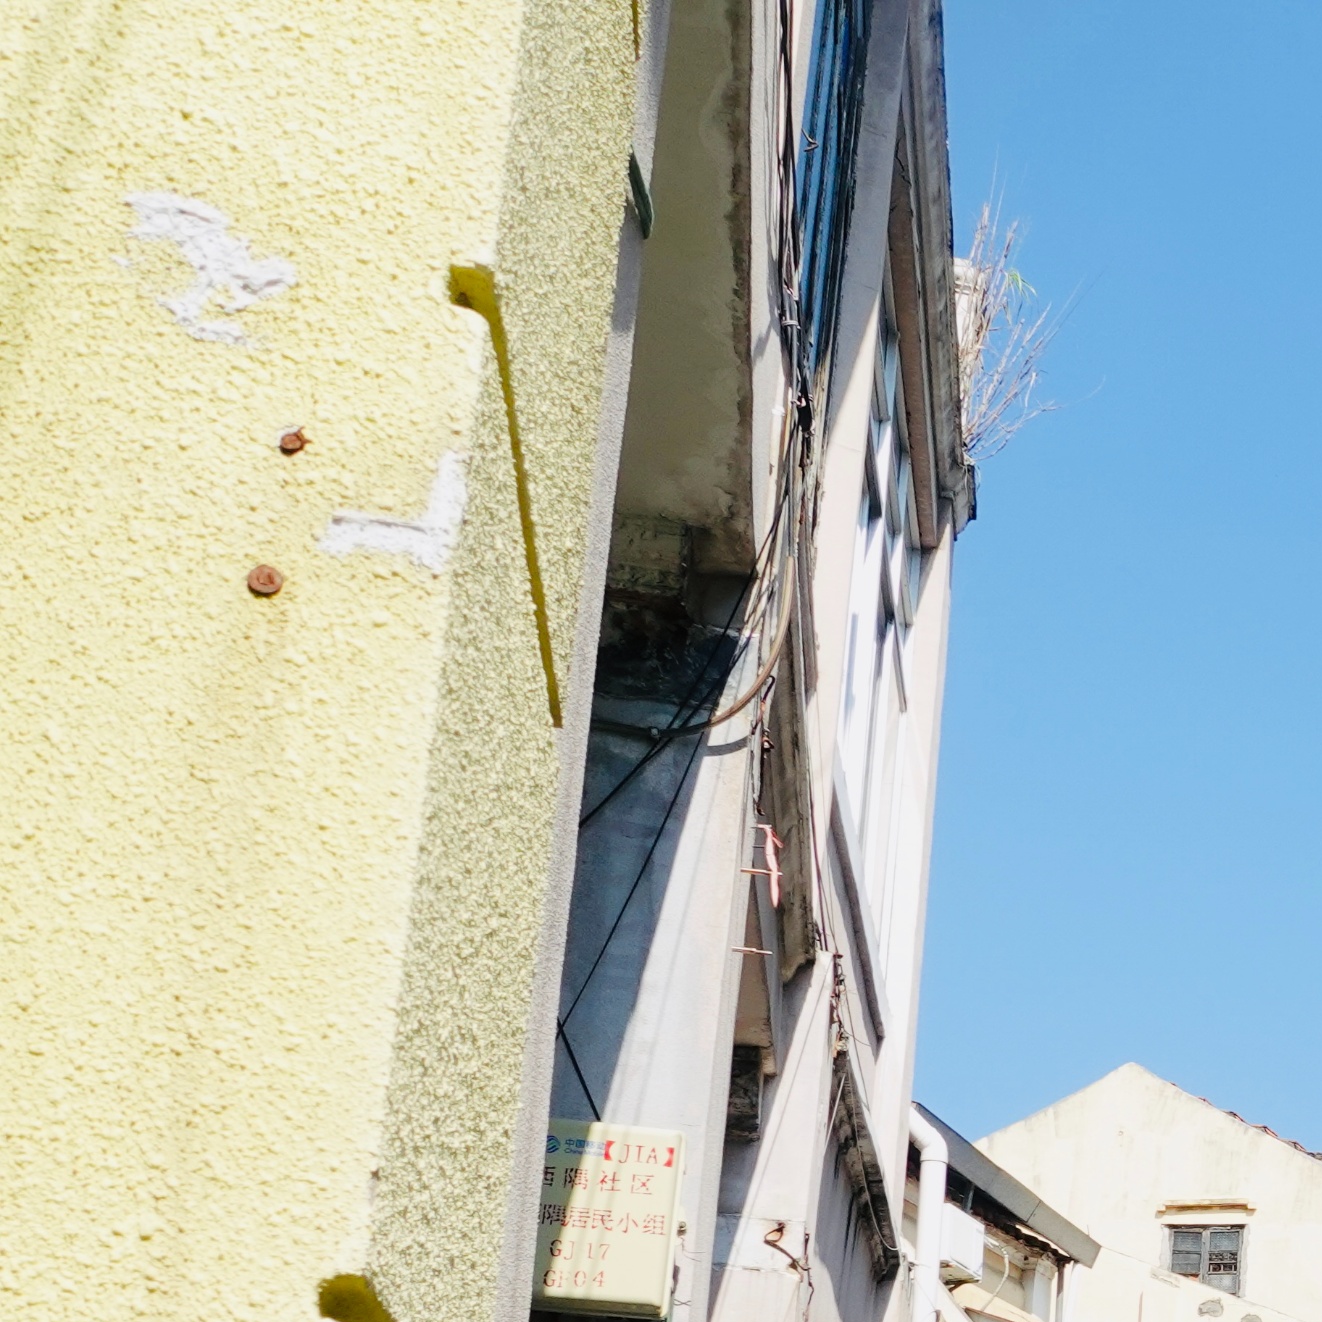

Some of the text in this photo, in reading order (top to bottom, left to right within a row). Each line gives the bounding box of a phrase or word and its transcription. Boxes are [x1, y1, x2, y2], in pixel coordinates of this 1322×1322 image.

[538, 1203, 667, 1236] 隅居民小组
